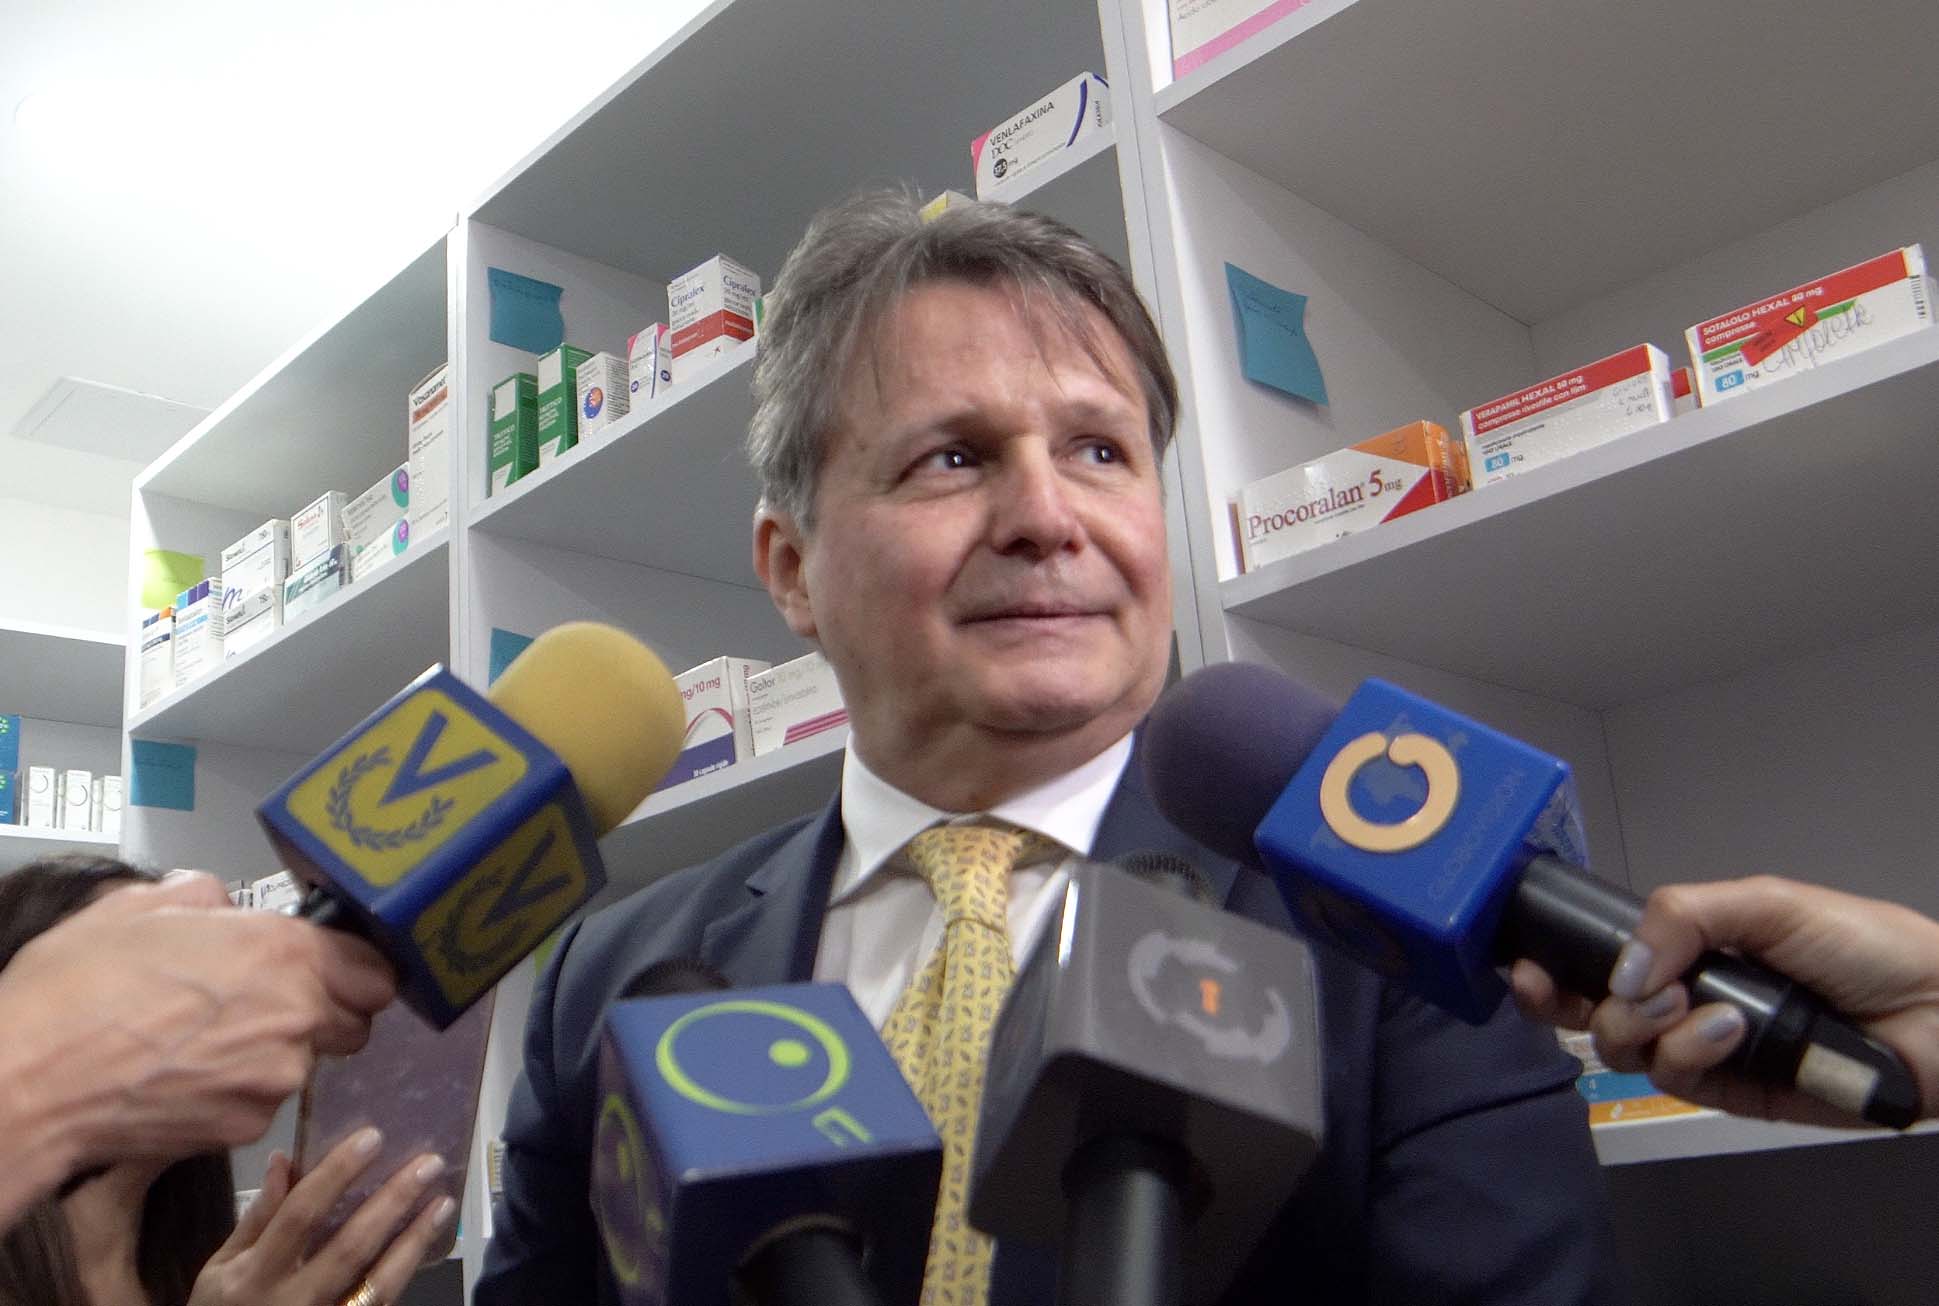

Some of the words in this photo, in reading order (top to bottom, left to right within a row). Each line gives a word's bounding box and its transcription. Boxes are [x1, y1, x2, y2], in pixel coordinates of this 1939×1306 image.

[990, 102, 1055, 146] VENLAFAXINA
[671, 286, 705, 307] Cipralex
[723, 274, 757, 297] Cipralex
[1703, 312, 1751, 336] SOTALOLO
[1751, 299, 1791, 318] HEXAL
[1806, 286, 1824, 299] mg
[1704, 321, 1757, 346] compresse
[1721, 375, 1737, 389] 80
[1745, 370, 1759, 382] mg
[1475, 397, 1521, 420] VERAPAMIL
[1520, 386, 1556, 404] HEXAL
[1568, 374, 1584, 389] mg
[1477, 408, 1521, 431] compresse
[1553, 390, 1570, 406] con
[1570, 383, 1587, 398] film
[1511, 454, 1524, 465] mg
[1247, 484, 1364, 541] Procoralan
[1368, 468, 1384, 498] 5
[1383, 478, 1402, 494] mg
[705, 676, 721, 691] mg
[750, 676, 776, 694] Goltor
